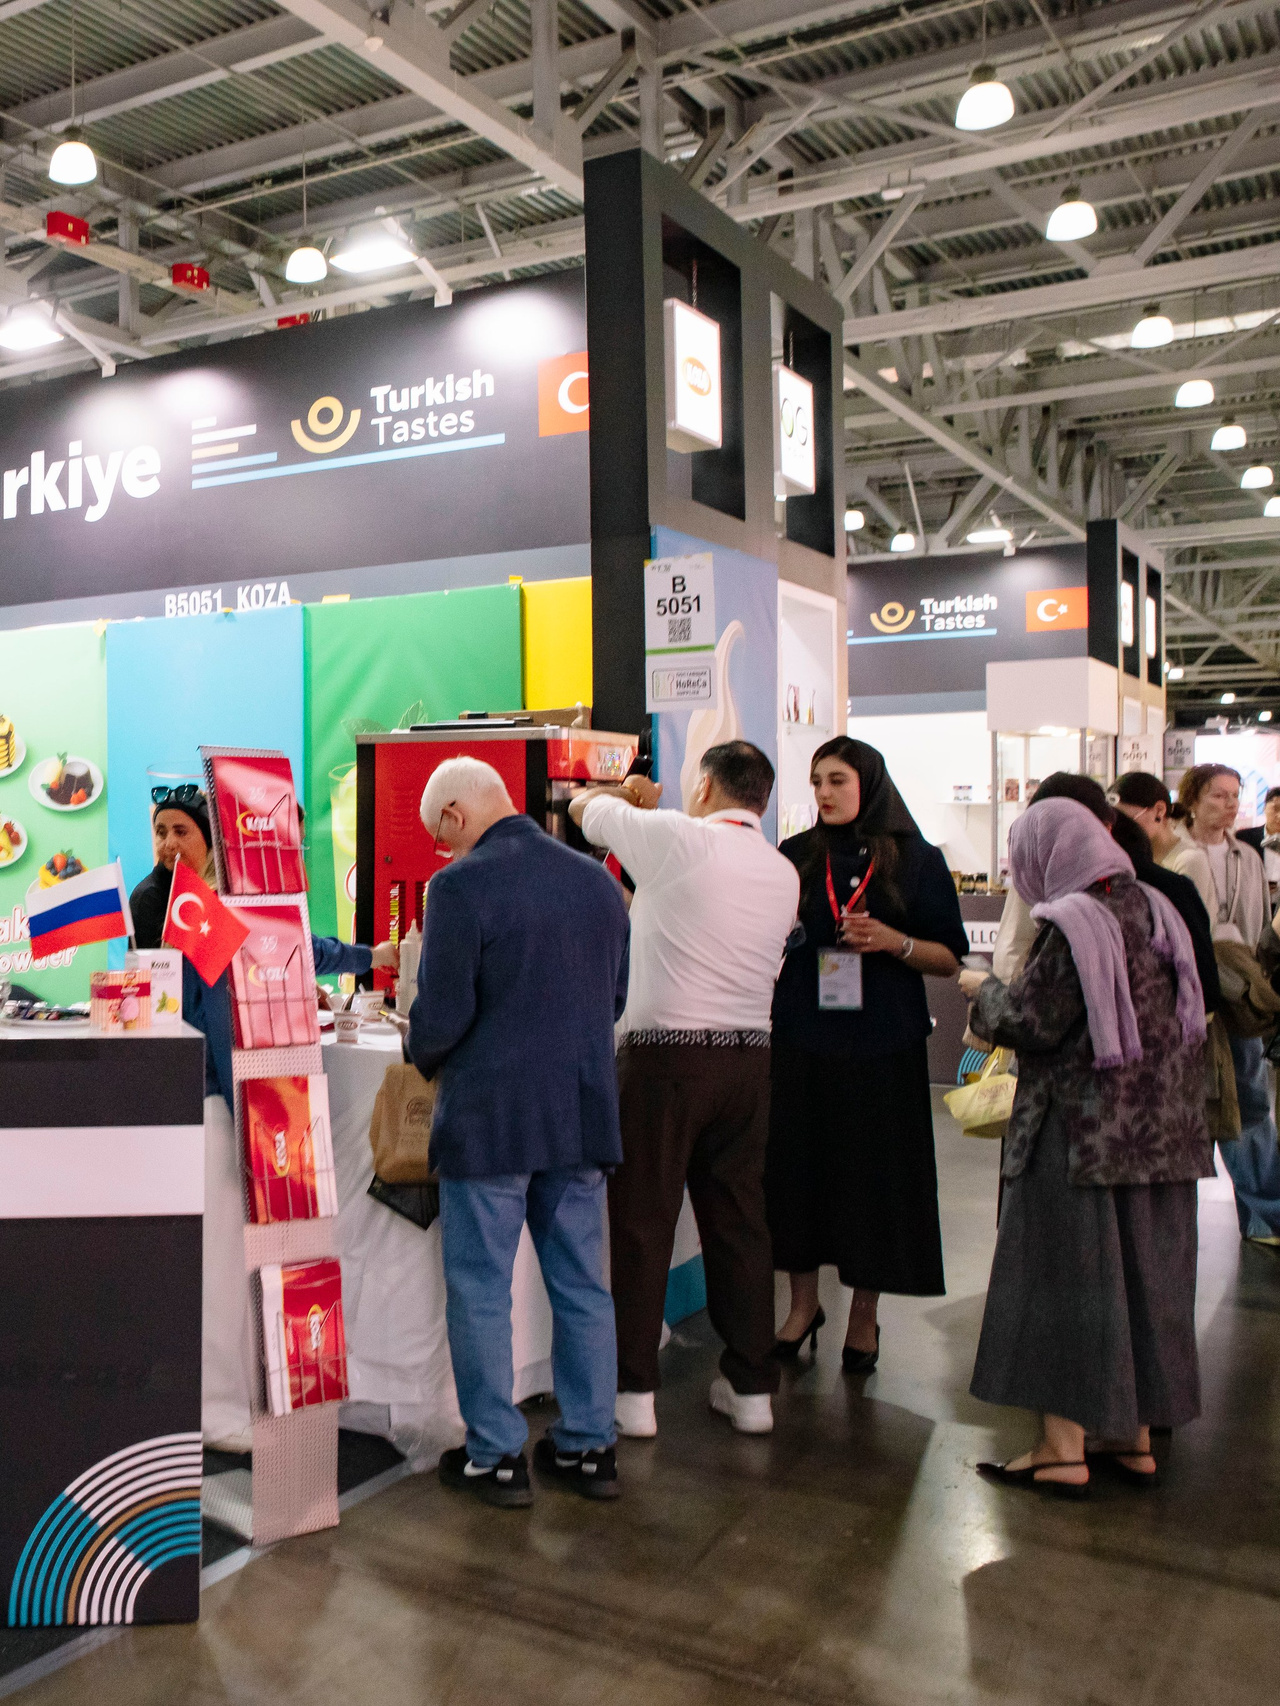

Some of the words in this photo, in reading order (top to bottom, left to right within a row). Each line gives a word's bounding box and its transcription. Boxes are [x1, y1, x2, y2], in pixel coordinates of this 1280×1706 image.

[370, 368, 495, 414] Turkish
[370, 410, 475, 446] Tastes
[671, 575, 687, 594] B
[236, 581, 292, 613] KOZA
[656, 594, 701, 617] 5051
[920, 593, 998, 614] Turkish
[920, 613, 987, 631] Tastes
